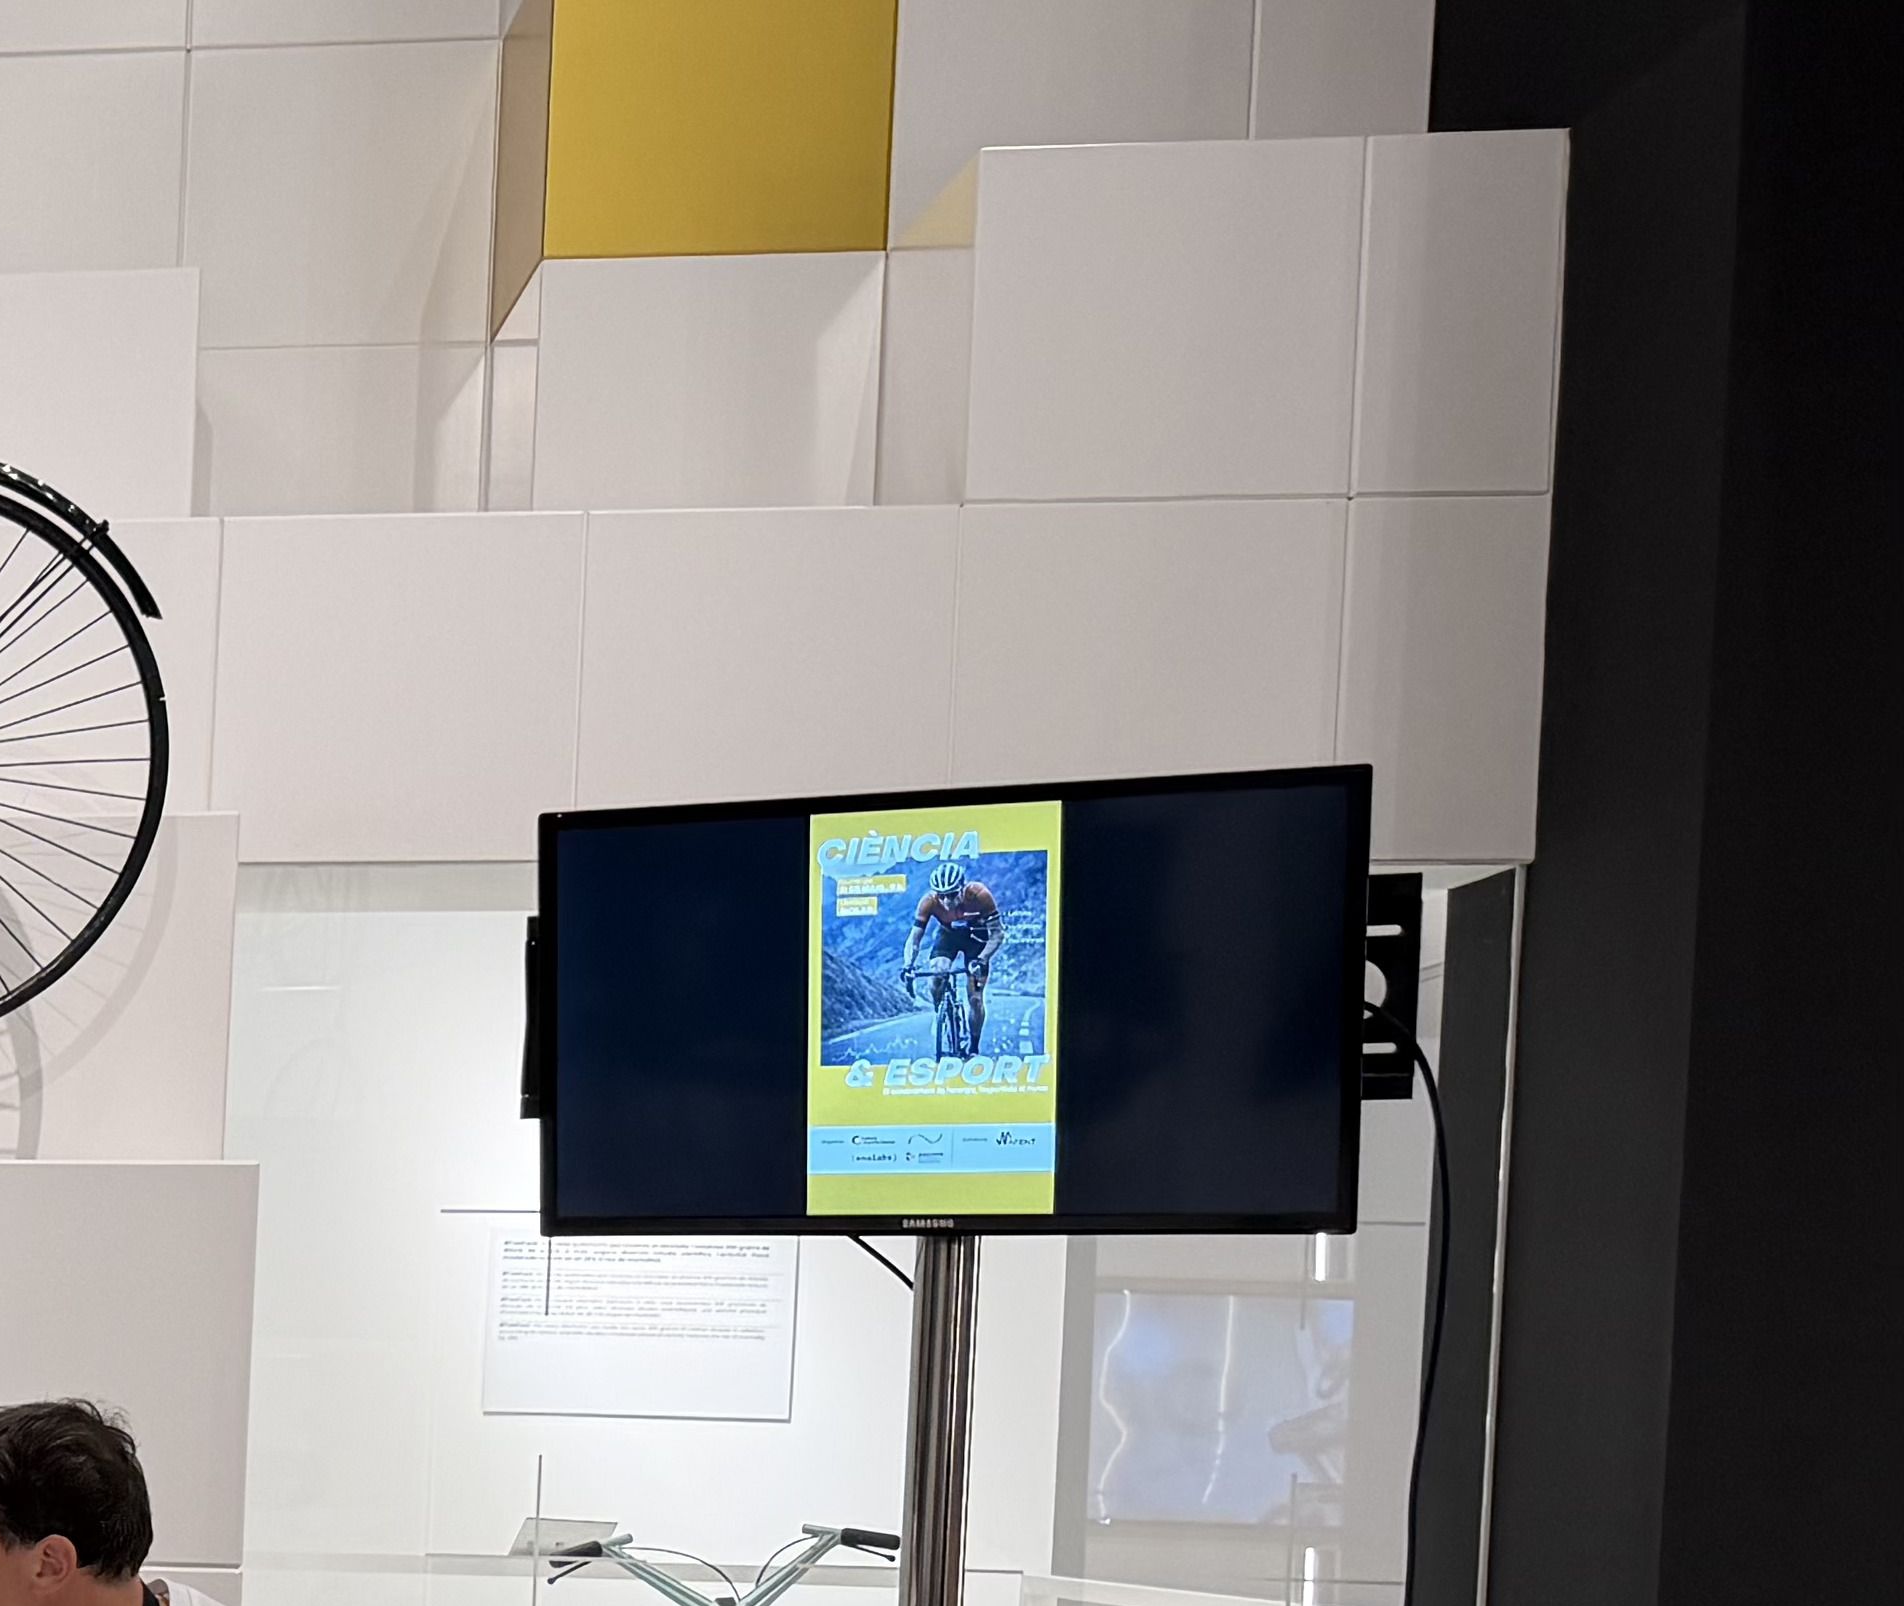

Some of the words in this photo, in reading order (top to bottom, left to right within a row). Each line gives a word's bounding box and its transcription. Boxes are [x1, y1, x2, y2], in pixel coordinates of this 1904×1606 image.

[817, 829, 980, 863] CIÈNCIA
[845, 1058, 874, 1087] &
[884, 1055, 1051, 1086] ESPORT
[901, 1218, 955, 1229] SAMSUNG
